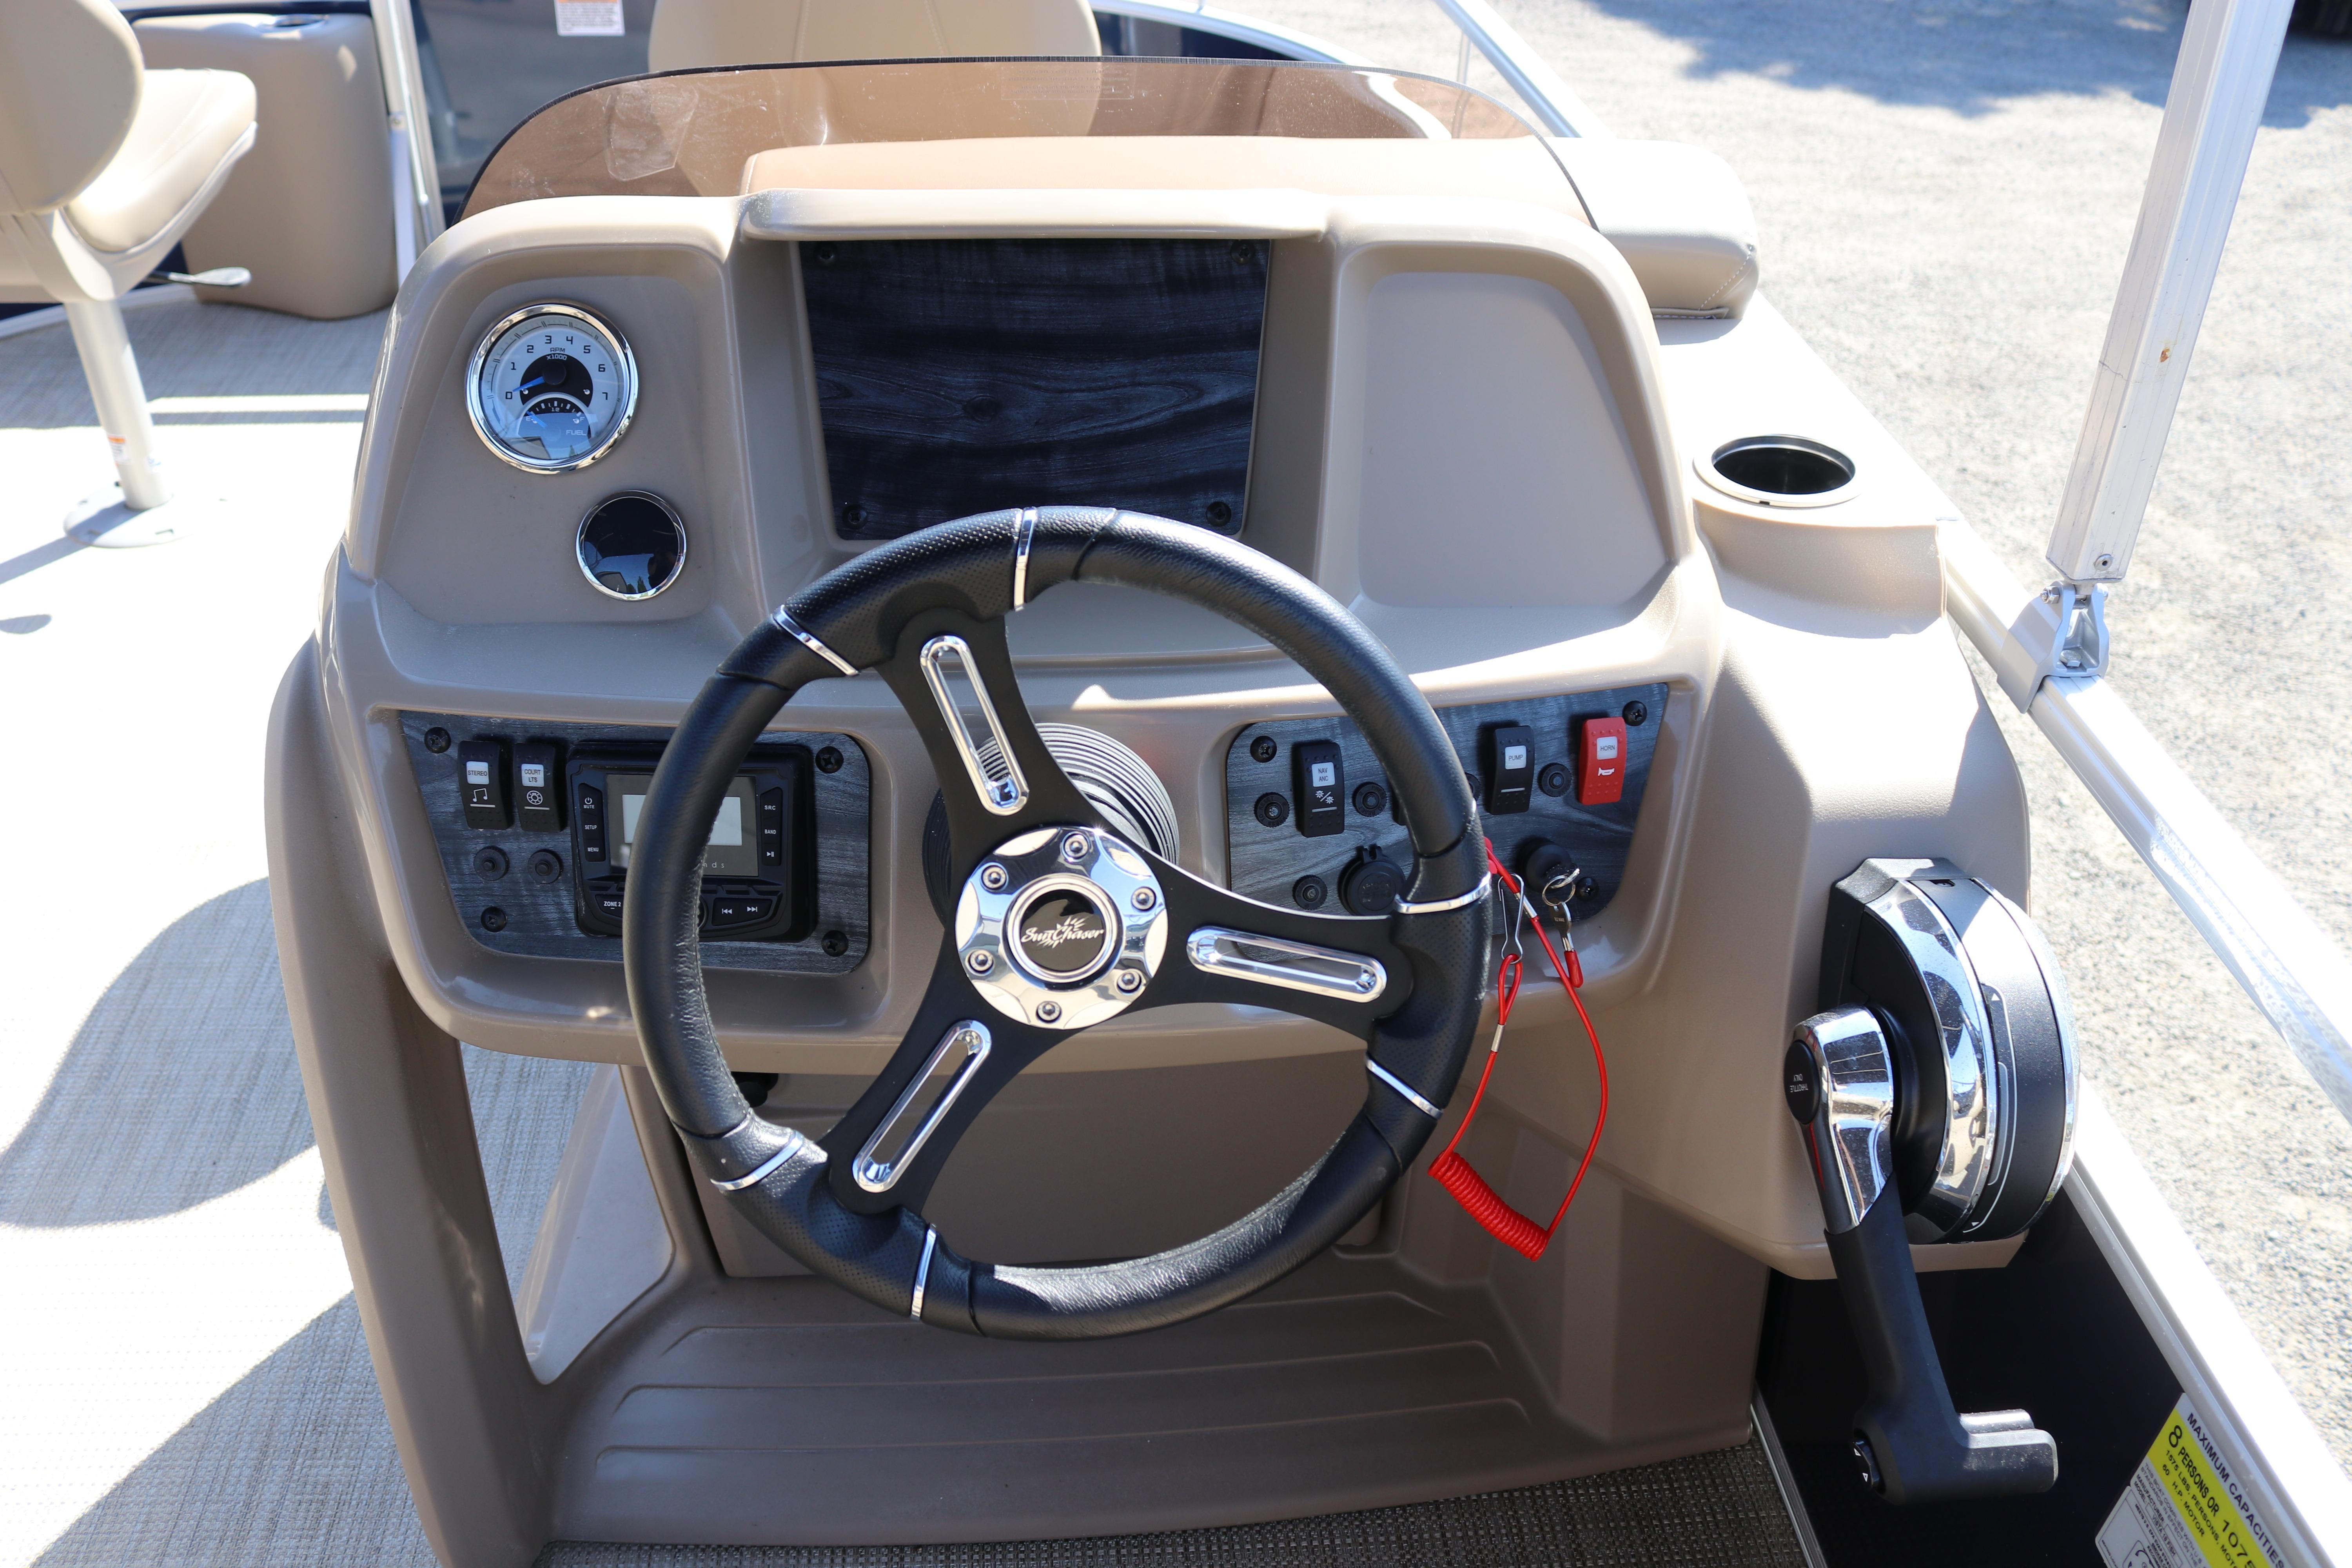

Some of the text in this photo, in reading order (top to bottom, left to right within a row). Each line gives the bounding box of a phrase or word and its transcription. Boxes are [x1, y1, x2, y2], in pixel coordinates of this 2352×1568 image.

[545, 336, 552, 344] 3
[566, 336, 573, 345] 4
[1790, 1083, 1808, 1092] THROTTLE
[1793, 1073, 1803, 1082] ONLY
[2167, 1450, 2178, 1471] 1575
[2169, 1425, 2182, 1448] 8
[2178, 1446, 2209, 1498] PERSONS
[2207, 1497, 2219, 1517] OR
[2141, 1467, 2163, 1506] STANDARDS
[2168, 1515, 2183, 1539] EFFECT
[2183, 1541, 2189, 1552] ON
[2145, 1463, 2154, 1478] THIS
[2153, 1479, 2164, 1496] BOAT
[2164, 1498, 2183, 1532] COMPLIES
[2184, 1534, 2194, 1550] WITH
[2163, 1465, 2169, 1475] 60
[2184, 1501, 2204, 1537] MOTOR
[2188, 1413, 2284, 1568] MAXIMUM CAPACITIES
[2152, 1515, 2162, 1533] VISTA
[2167, 1541, 2175, 1555] FISH
